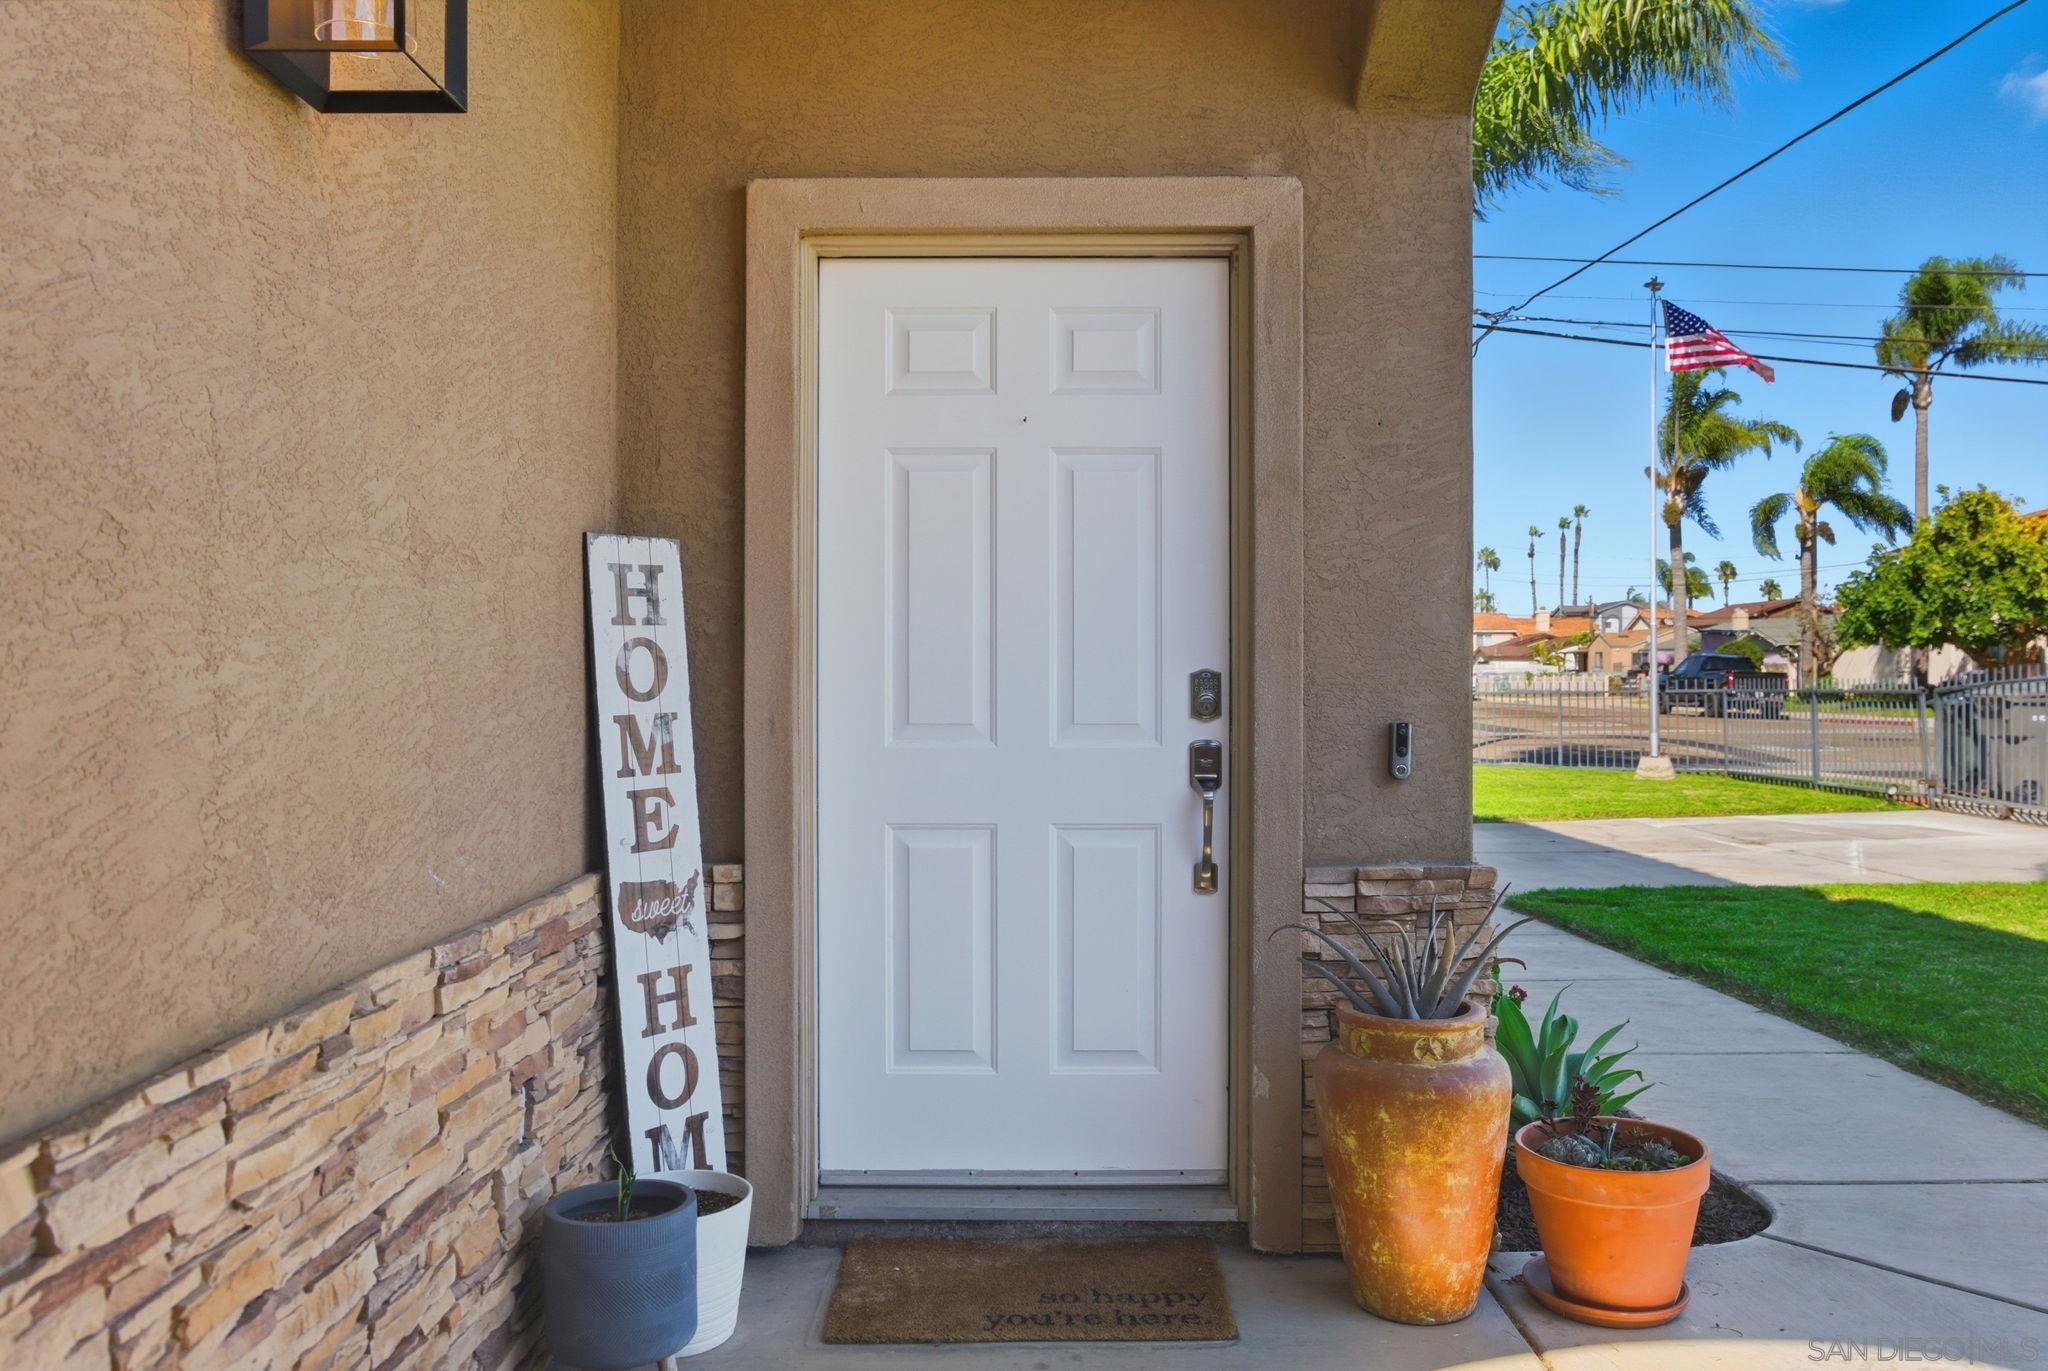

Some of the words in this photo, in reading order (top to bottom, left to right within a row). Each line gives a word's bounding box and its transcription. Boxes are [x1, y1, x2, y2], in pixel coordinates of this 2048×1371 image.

[607, 562, 682, 854] HOME
[631, 893, 691, 922] sweet
[1040, 1290, 1080, 1305] so
[1090, 1287, 1206, 1308] happy
[981, 1309, 1101, 1331] you're
